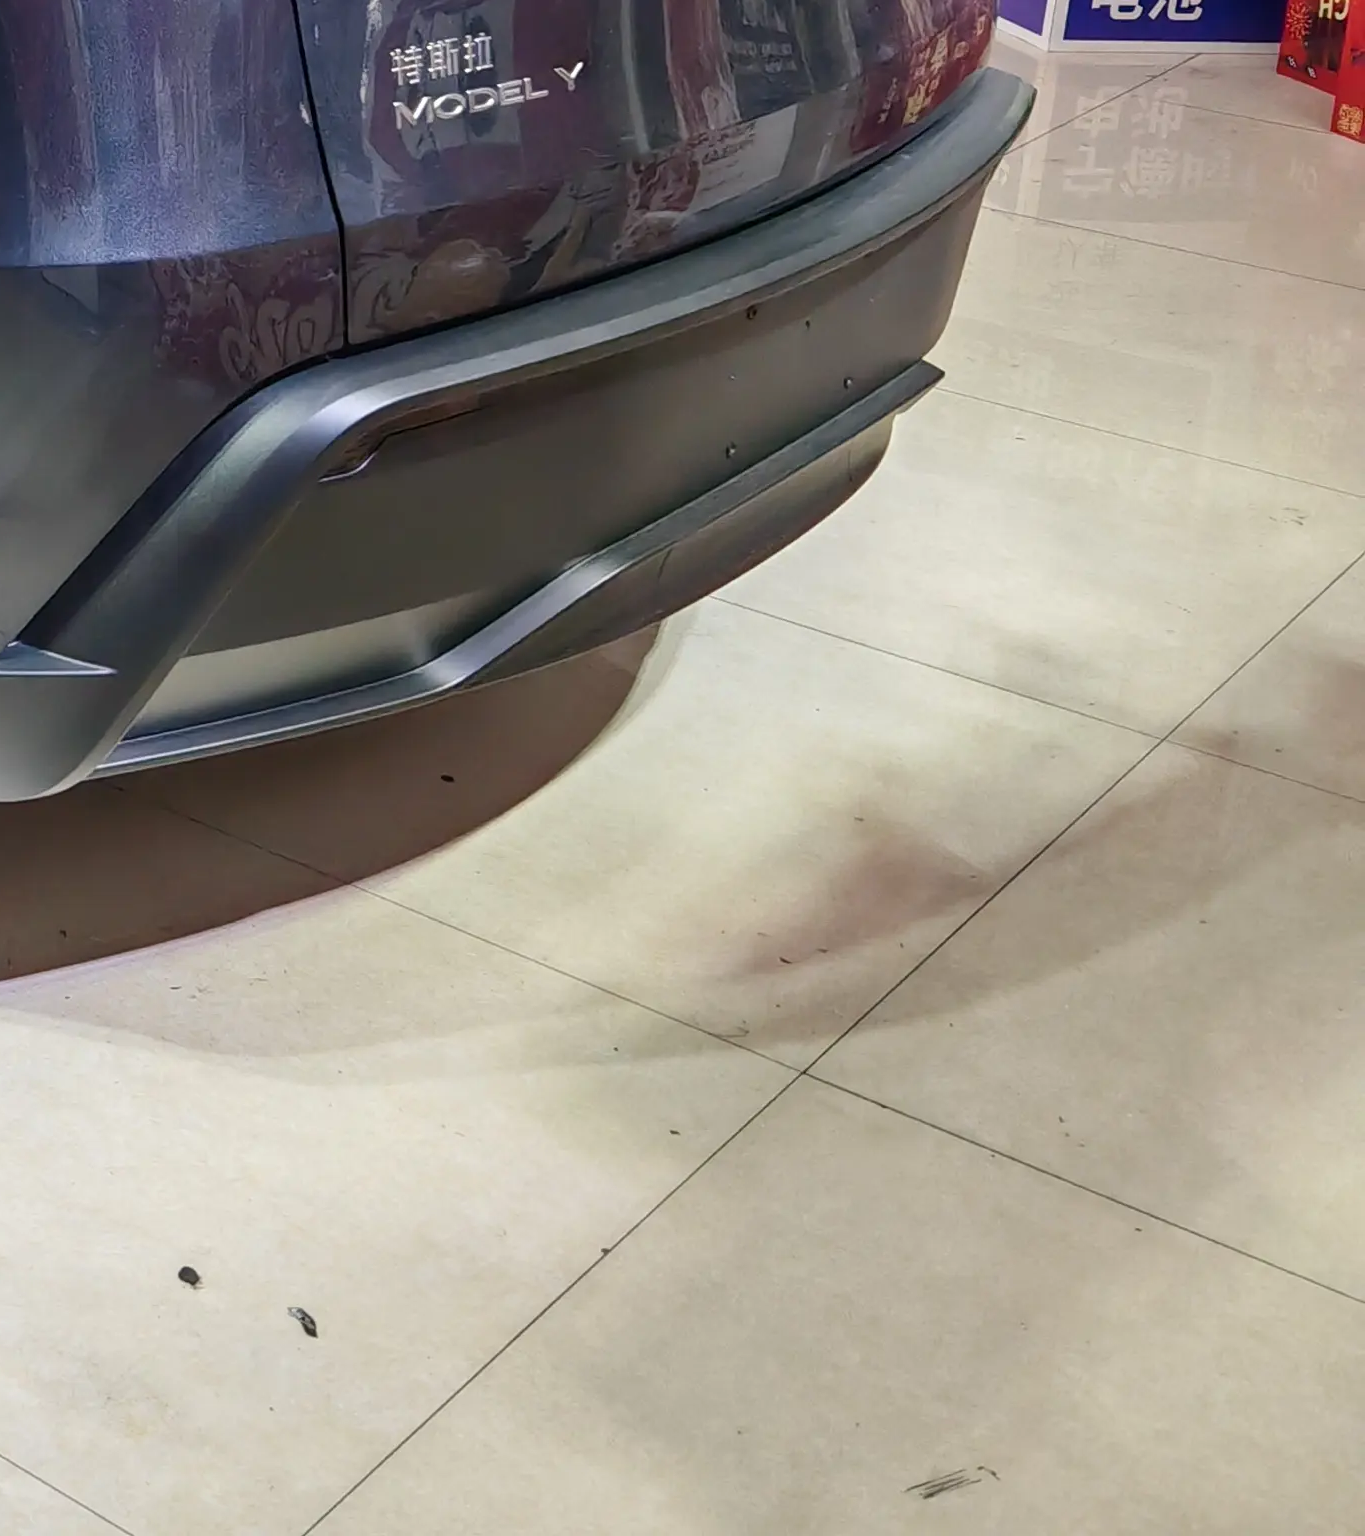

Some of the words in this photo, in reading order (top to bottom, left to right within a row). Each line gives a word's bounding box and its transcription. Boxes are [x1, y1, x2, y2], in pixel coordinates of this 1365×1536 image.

[390, 32, 494, 86] 特斯拉
[393, 76, 550, 130] MODEL
[554, 61, 584, 91] Y
